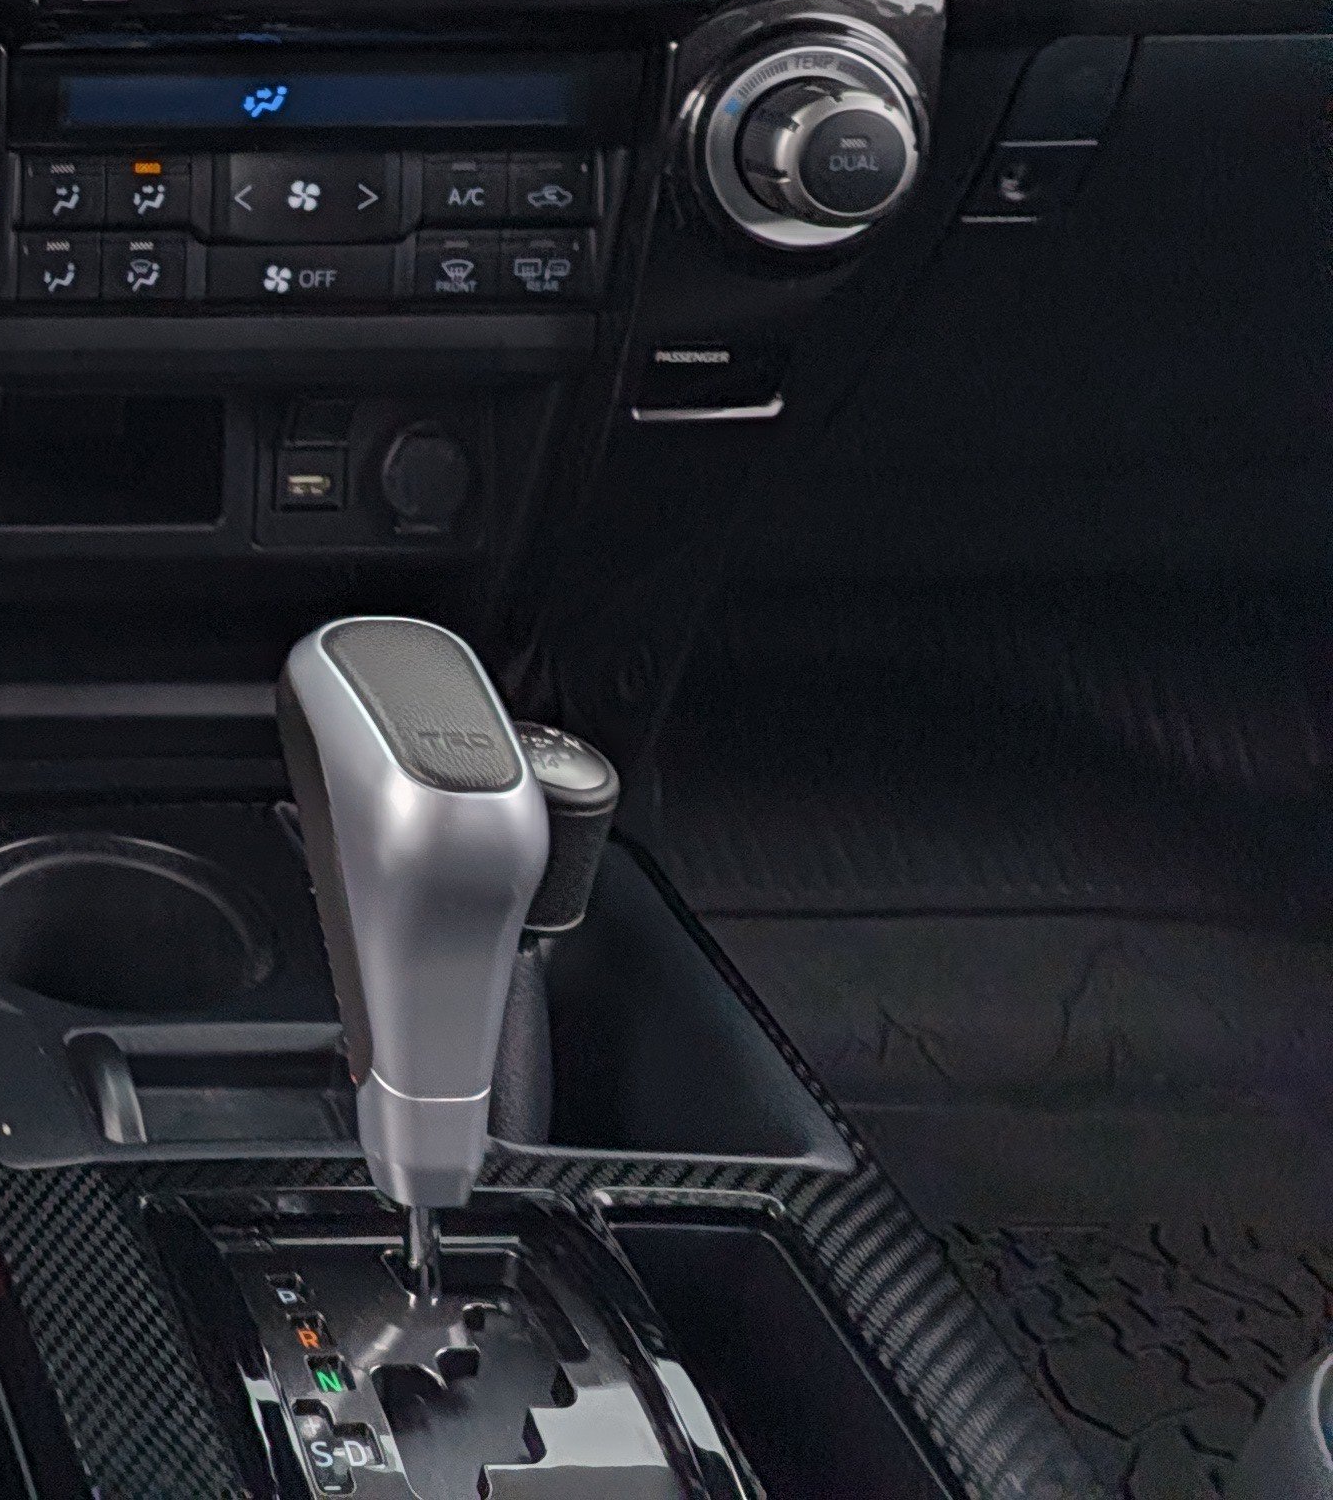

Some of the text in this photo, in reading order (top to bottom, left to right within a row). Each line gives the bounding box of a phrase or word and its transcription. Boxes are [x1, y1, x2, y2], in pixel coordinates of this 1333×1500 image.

[793, 54, 837, 71] TEMP
[829, 155, 879, 172] DUAL
[448, 187, 484, 206] A/C
[298, 269, 337, 288] OFF
[435, 280, 479, 292] FRONT
[526, 280, 560, 292] REAR
[655, 350, 730, 363] PASSENGER
[296, 1328, 321, 1349] R
[315, 1369, 343, 1392] N
